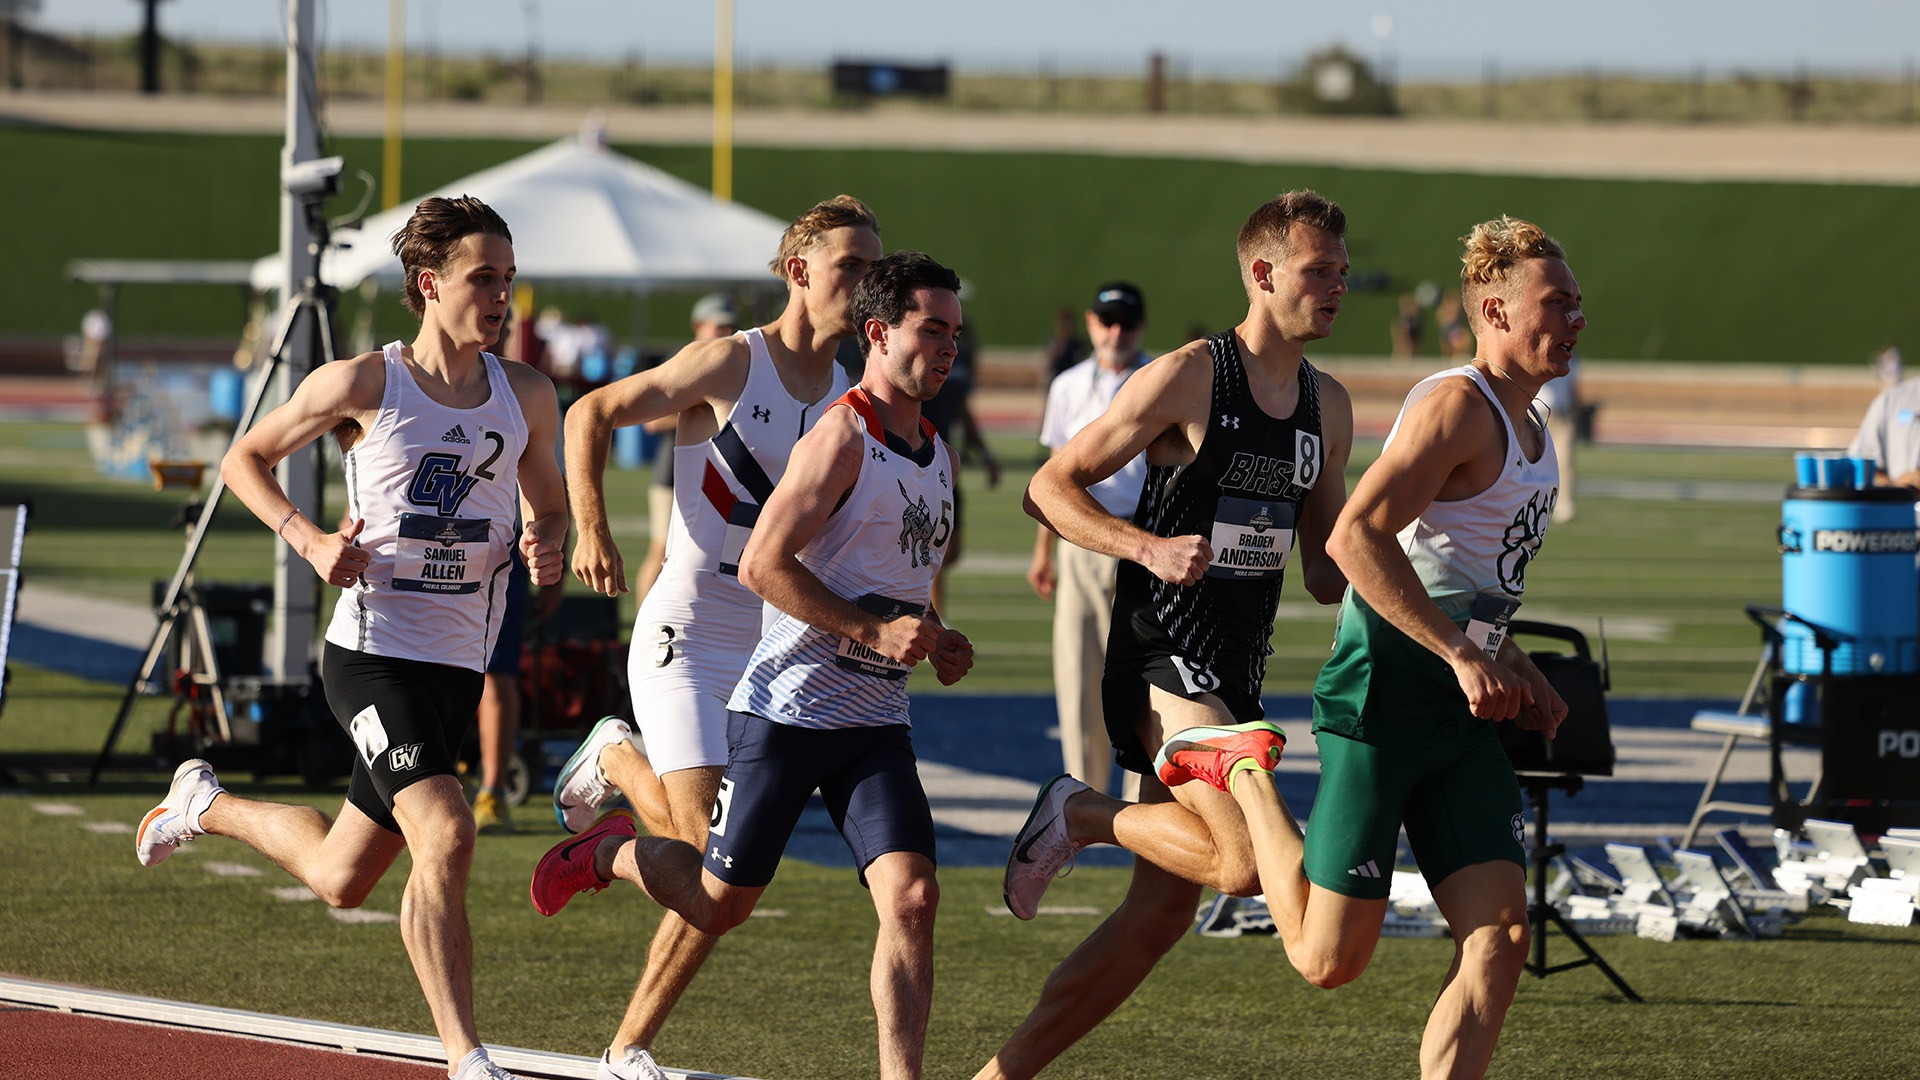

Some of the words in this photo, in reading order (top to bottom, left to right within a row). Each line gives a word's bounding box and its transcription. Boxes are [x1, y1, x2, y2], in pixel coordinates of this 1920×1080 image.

[441, 435, 471, 445] adidas
[474, 431, 505, 481] 2
[1300, 434, 1315, 485] 8
[407, 452, 480, 517] GV
[933, 500, 952, 548] 5
[424, 547, 467, 562] SAMUEL
[1239, 533, 1275, 549] BRADEN
[421, 562, 465, 581] ALLEN
[1218, 547, 1283, 568] ANDERSON
[656, 625, 676, 668] 3
[1182, 656, 1214, 691] 8
[388, 742, 424, 772] GV
